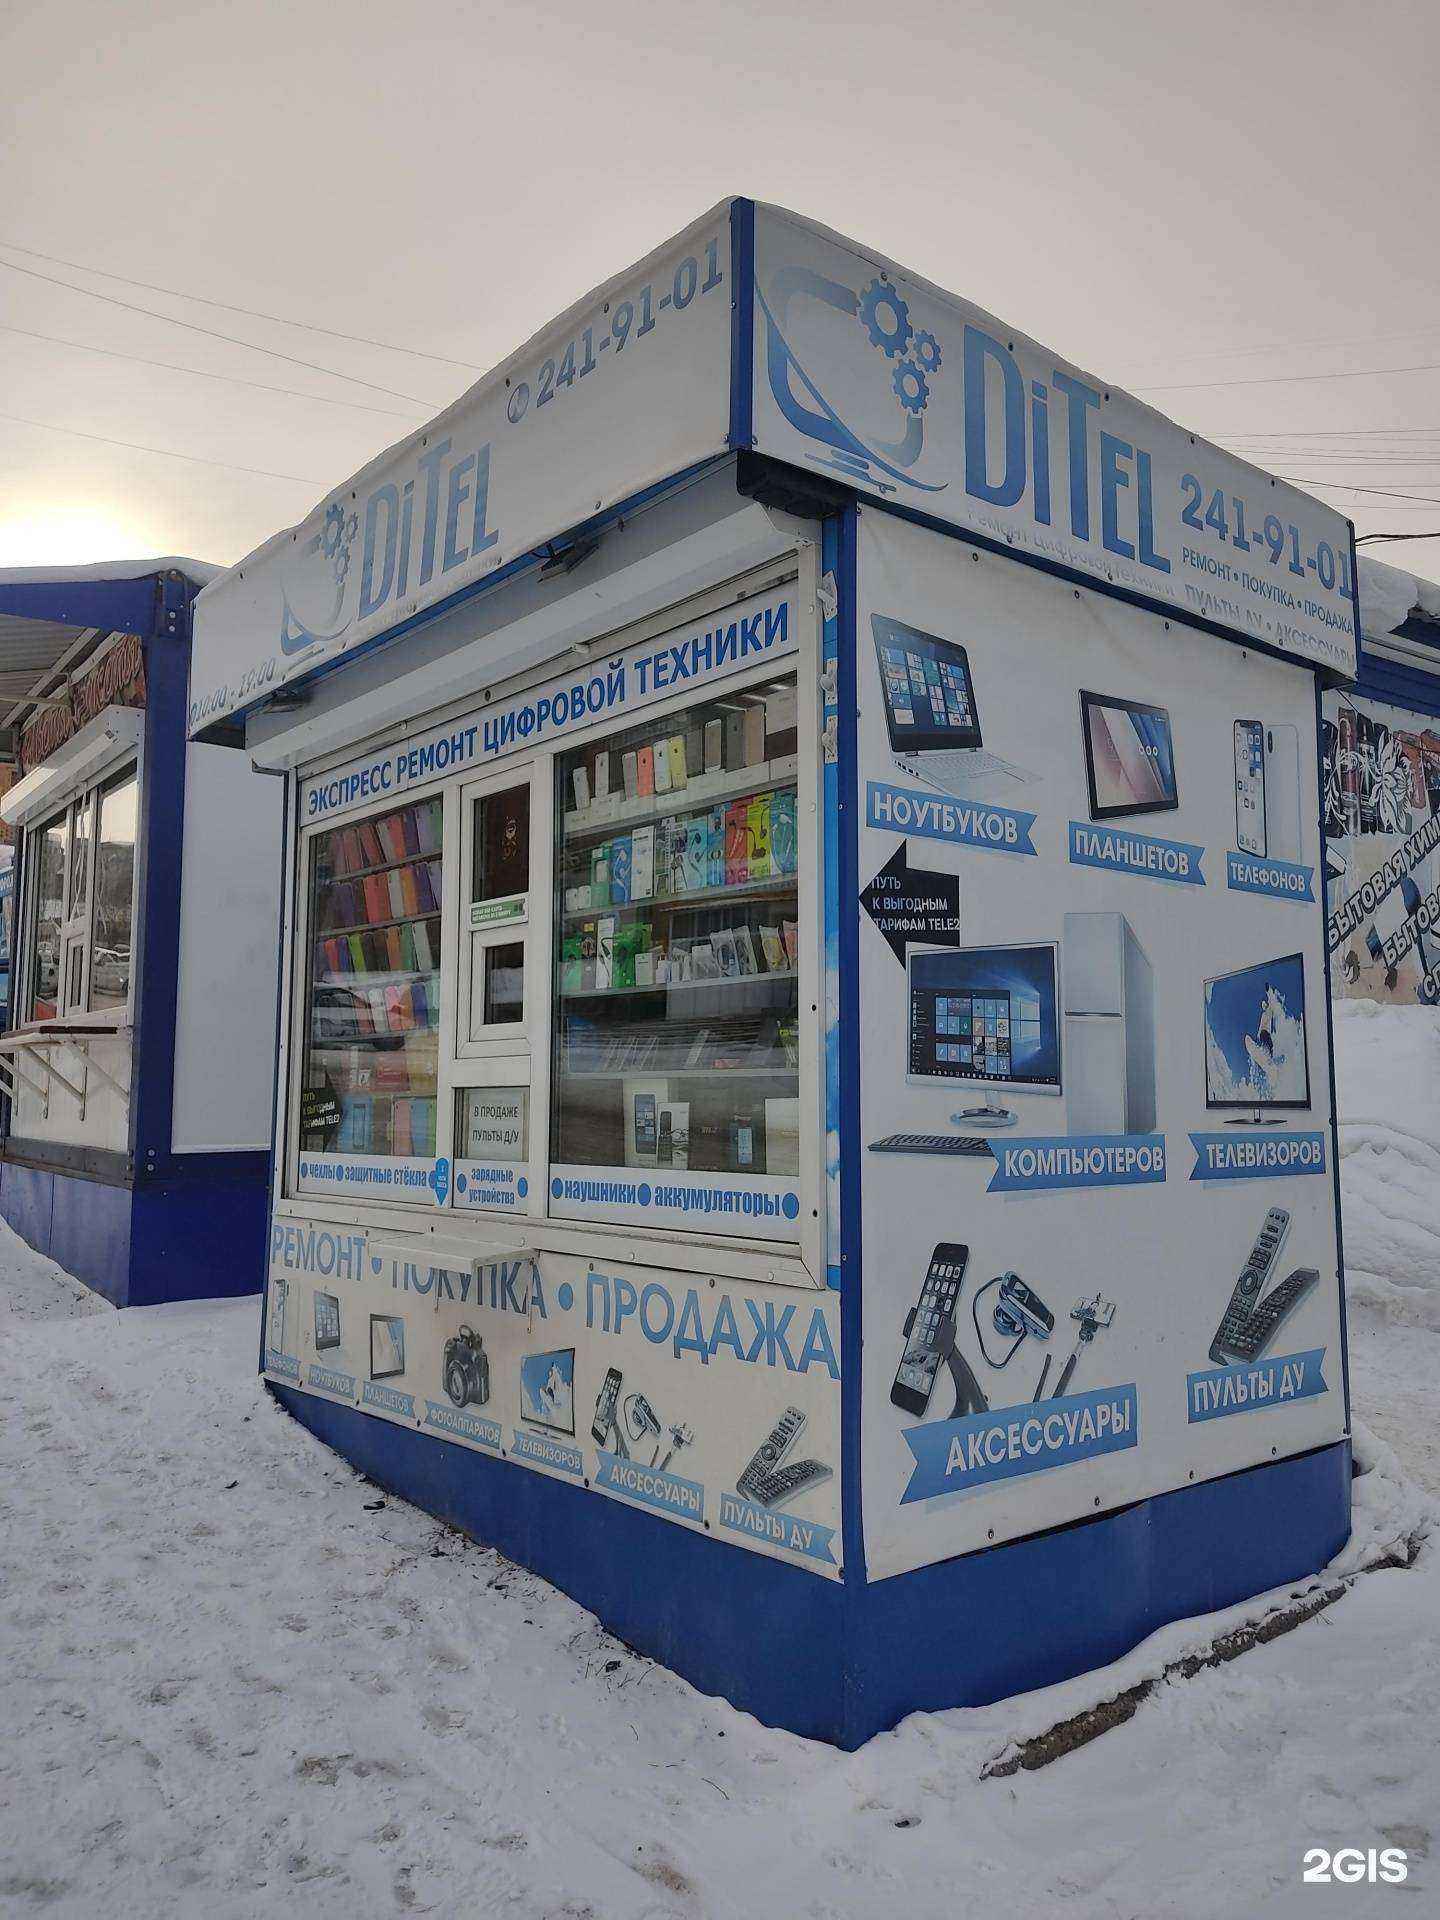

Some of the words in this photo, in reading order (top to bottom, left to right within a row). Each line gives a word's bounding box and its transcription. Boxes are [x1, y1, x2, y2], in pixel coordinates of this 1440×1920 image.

[536, 236, 723, 409] 241-91-01
[963, 325, 1171, 574] DiTEL
[357, 437, 499, 621] DiTEL
[1179, 473, 1353, 601] 241-91-01
[1182, 547, 1231, 582] РЕМОНТ
[1242, 574, 1295, 610] ПОКУПКА
[1304, 600, 1354, 636] ПРОДАЖА
[308, 761, 392, 816] ЭКСПРЕСС
[396, 726, 478, 784] РЕМОНТ
[483, 657, 625, 754] ЦИФРОВОЙ
[633, 601, 788, 695] ТЕХНИКИ
[873, 791, 1018, 844] НОУТБУКОВ
[1075, 829, 1189, 875] ПЛАНШЕТОВ
[872, 877, 901, 890] ПУТЬ
[1230, 862, 1306, 892] ТЕЛЕФОНОВ
[872, 897, 881, 910] К
[883, 898, 948, 913] ВЫГОДНЫМ
[1328, 849, 1408, 952] БЫТОВАЯ
[874, 917, 926, 931] ТАРИФАМ
[928, 918, 960, 931] TELE2
[1383, 885, 1440, 968] БЫТОВ
[473, 1106, 480, 1118] В
[481, 1104, 519, 1120] ПРОДАЖЕ
[472, 1129, 502, 1143] ПУЛЬТЫ
[504, 1130, 519, 1144] Д/У
[1206, 1141, 1322, 1169] ТЕЛЕВИЗОРОВ
[309, 1163, 336, 1180] чехлы
[344, 1165, 392, 1187] защитные
[393, 1165, 427, 1187] стёкла
[471, 1167, 514, 1184] зарядные
[1004, 1145, 1164, 1177] КОМПЬЮТЕРОВ
[468, 1187, 515, 1205] устройства
[564, 1179, 636, 1204] наушники
[654, 1185, 780, 1217] аккумуляторы
[271, 1224, 366, 1281] РЕМОНТ
[586, 1272, 841, 1380] ПРОДАЖА
[1193, 1369, 1274, 1413] ПУЛЬТЫ
[1279, 1362, 1306, 1399] ДУ
[430, 1407, 500, 1442] ФОТОАППАРАТОВ
[945, 1399, 1131, 1475] АКСЕССУАРЫ
[519, 1438, 582, 1469] ТЕЛЕВИЗОРОВ
[610, 1467, 700, 1509] АКСЕССУАРЫ
[723, 1501, 785, 1540] ПУЛЬТЫ
[790, 1525, 813, 1550] ДУ
